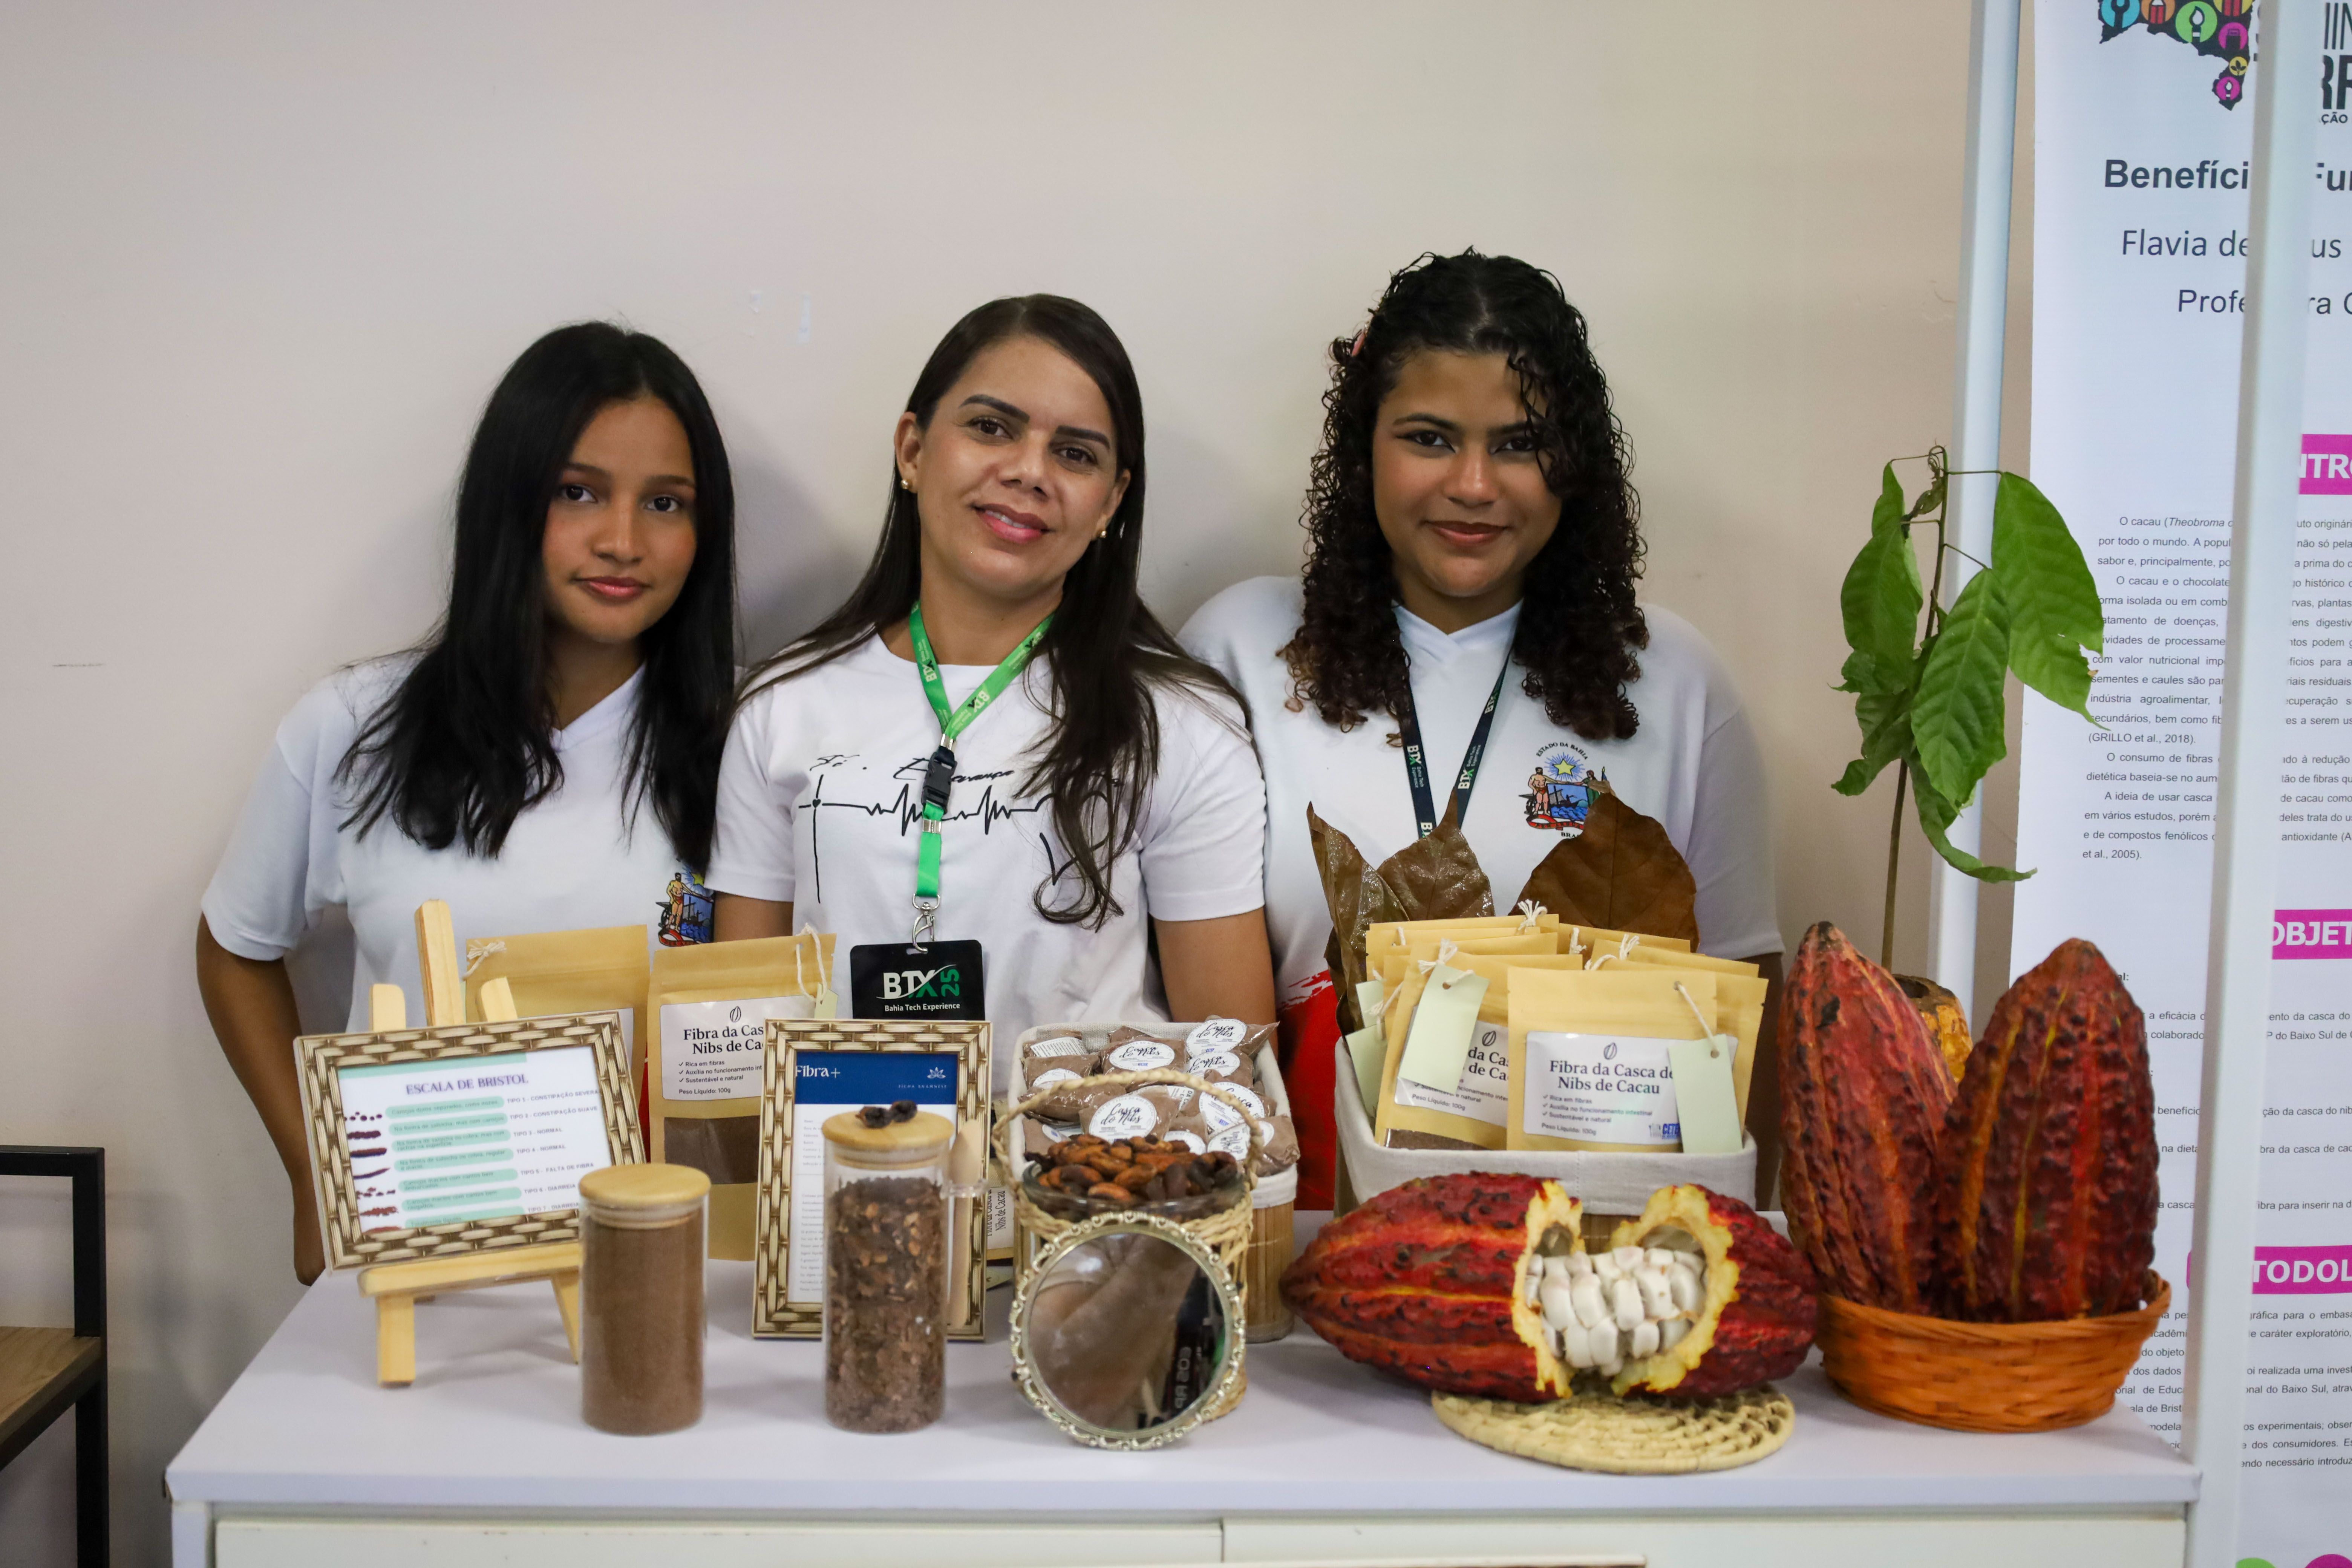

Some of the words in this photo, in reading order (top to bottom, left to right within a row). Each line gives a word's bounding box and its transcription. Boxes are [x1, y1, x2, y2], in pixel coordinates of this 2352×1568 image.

[2105, 159, 2248, 189] Benefíci
[2123, 229, 2207, 256] Flavia
[2164, 518, 2225, 528] (Theobroma
[2153, 537, 2189, 546] mundo.
[2318, 539, 2329, 548] só
[2098, 556, 2125, 565] sabor
[2141, 557, 2215, 567] principalmente,
[2303, 559, 2329, 569] prima
[2305, 579, 2344, 587] histórico
[2174, 617, 2218, 628] doenças,
[2119, 655, 2143, 664] valor
[2149, 656, 2199, 665] nutricional
[2090, 674, 2138, 684] sementes
[2152, 676, 2184, 684] caules
[2309, 677, 2351, 686] residuais
[2091, 694, 2131, 703] indústria
[2140, 695, 2210, 705] agroalimentar,
[2089, 733, 2132, 743] (GRILLO
[2147, 734, 2161, 743] al.,
[2165, 734, 2195, 745] 2018).
[1407, 745, 1422, 765] BTX
[1536, 742, 1558, 757] ESTADO
[1570, 744, 1588, 760] BAHIA
[2186, 754, 2213, 763] fibras
[2312, 755, 2350, 766] redução
[1458, 769, 1474, 789] BTX
[2087, 772, 2126, 781] dietética
[2130, 773, 2177, 782] baseia-se
[2115, 792, 2138, 800] ideia
[2135, 812, 2175, 821] estudos,
[2179, 813, 2210, 822] porém
[2109, 831, 2161, 841] compostos
[2165, 831, 2208, 840] fenólicos
[2094, 850, 2108, 859] al.,
[2112, 850, 2141, 860] 2005).
[884, 969, 938, 999] BTX
[940, 969, 960, 997] 25
[923, 1003, 960, 1011] Experience
[2159, 1011, 2196, 1020] eficácia
[1207, 1023, 1234, 1031] Casca
[684, 1028, 718, 1040] Fibra
[722, 1026, 738, 1037] da
[741, 1026, 764, 1036] Cas
[2290, 1031, 2315, 1040] Baixo
[2318, 1031, 2333, 1039] Sul
[693, 1042, 722, 1054] Nibs
[726, 1040, 741, 1052] de
[1468, 1047, 1484, 1060] da
[1468, 1063, 1485, 1075] de
[1550, 1060, 1587, 1074] Fibra
[1592, 1063, 1609, 1075] da
[1614, 1064, 1655, 1078] Casca
[406, 1081, 453, 1095] ESCALA
[458, 1079, 474, 1090] DE
[478, 1073, 528, 1088] BRISTOL
[1558, 1076, 1591, 1089] Nibs
[1596, 1079, 1612, 1091] de
[1617, 1080, 1659, 1094] Cacau
[530, 1092, 573, 1101] CONSTIPAÇÃO
[1111, 1103, 1141, 1115] Casca
[995, 1191, 1005, 1208] Cacau
[2278, 1202, 2299, 1211] para
[2302, 1200, 2329, 1209] inserir
[995, 1217, 1006, 1231] Nibs
[2296, 1329, 2351, 1339] exploratório,
[2156, 1348, 2185, 1358] objeto
[2258, 1422, 2323, 1432] experimentais;
[2266, 1458, 2314, 1466] necessário
